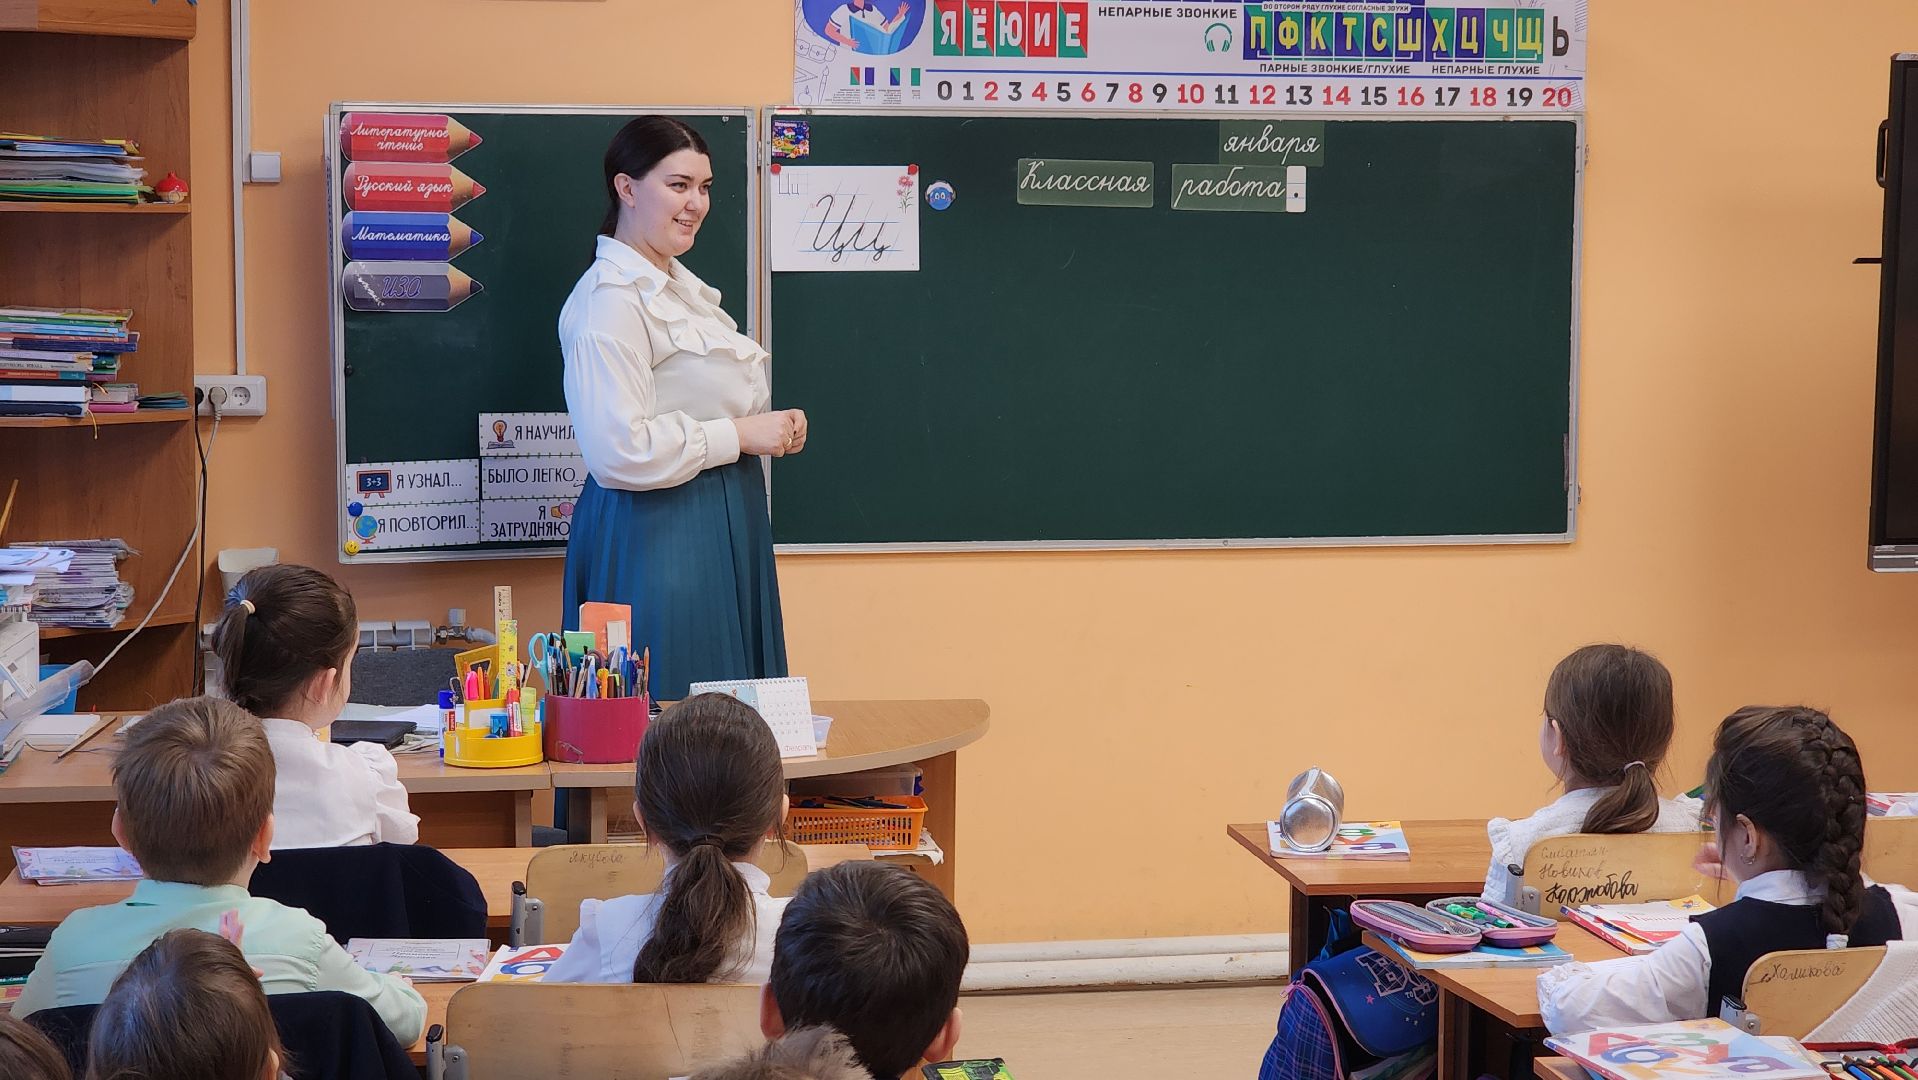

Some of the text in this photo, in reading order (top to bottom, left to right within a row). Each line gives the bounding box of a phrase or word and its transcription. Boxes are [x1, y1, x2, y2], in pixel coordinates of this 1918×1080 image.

[1098, 6, 1238, 19] НЕПАРНЫЕ ЗВОНКИЕ
[1347, 4, 1387, 12] СОГЛАСНЫЕ
[940, 7, 1081, 48] Я Ё Ю И Е
[1250, 16, 1543, 55] П Ф К Т С Ш Х Ц Ч Щ
[1552, 16, 1570, 56] Ь
[1260, 63, 1411, 74] ПАРНЫЕ ЗВОНКИЕ/ГЛУХИЕ
[1432, 65, 1540, 76] НЕПАРНЫЕ ГЛУХИЕ
[937, 80, 953, 100] 0
[962, 81, 975, 100] 1
[984, 81, 999, 100] 2
[1008, 81, 1023, 101] 3
[1032, 81, 1048, 102] 4
[1056, 82, 1072, 102] 5
[1080, 82, 1096, 102] 6
[1106, 82, 1120, 102] 7
[1128, 82, 1144, 102] 8
[1152, 83, 1168, 103] 9
[1177, 83, 1205, 104] 10
[1214, 84, 1239, 104] 11
[1250, 84, 1276, 105] 12
[1285, 85, 1312, 106] 13
[1322, 85, 1351, 106] 14
[1361, 86, 1388, 106] 15
[1398, 86, 1425, 106] 16
[1434, 87, 1461, 106] 17
[1470, 87, 1497, 106] 18
[1506, 88, 1534, 107] 19
[1542, 88, 1573, 108] 20
[350, 122, 449, 142] Литературное
[376, 141, 424, 152] чтение
[1223, 124, 1320, 165] января
[1020, 160, 1151, 193] Классная
[354, 175, 454, 199] Русский язык
[351, 226, 451, 242] Математика
[381, 275, 423, 298] ИЗО
[515, 425, 575, 440] Я НАУЧИЛ
[396, 472, 462, 489] Я УЗНАЛ...
[488, 468, 528, 484] БЫЛО
[538, 506, 546, 520] Я
[378, 514, 478, 534] Я ПОВТОРИЛ...
[490, 521, 571, 538] ЗАТРУДНЯЮ
